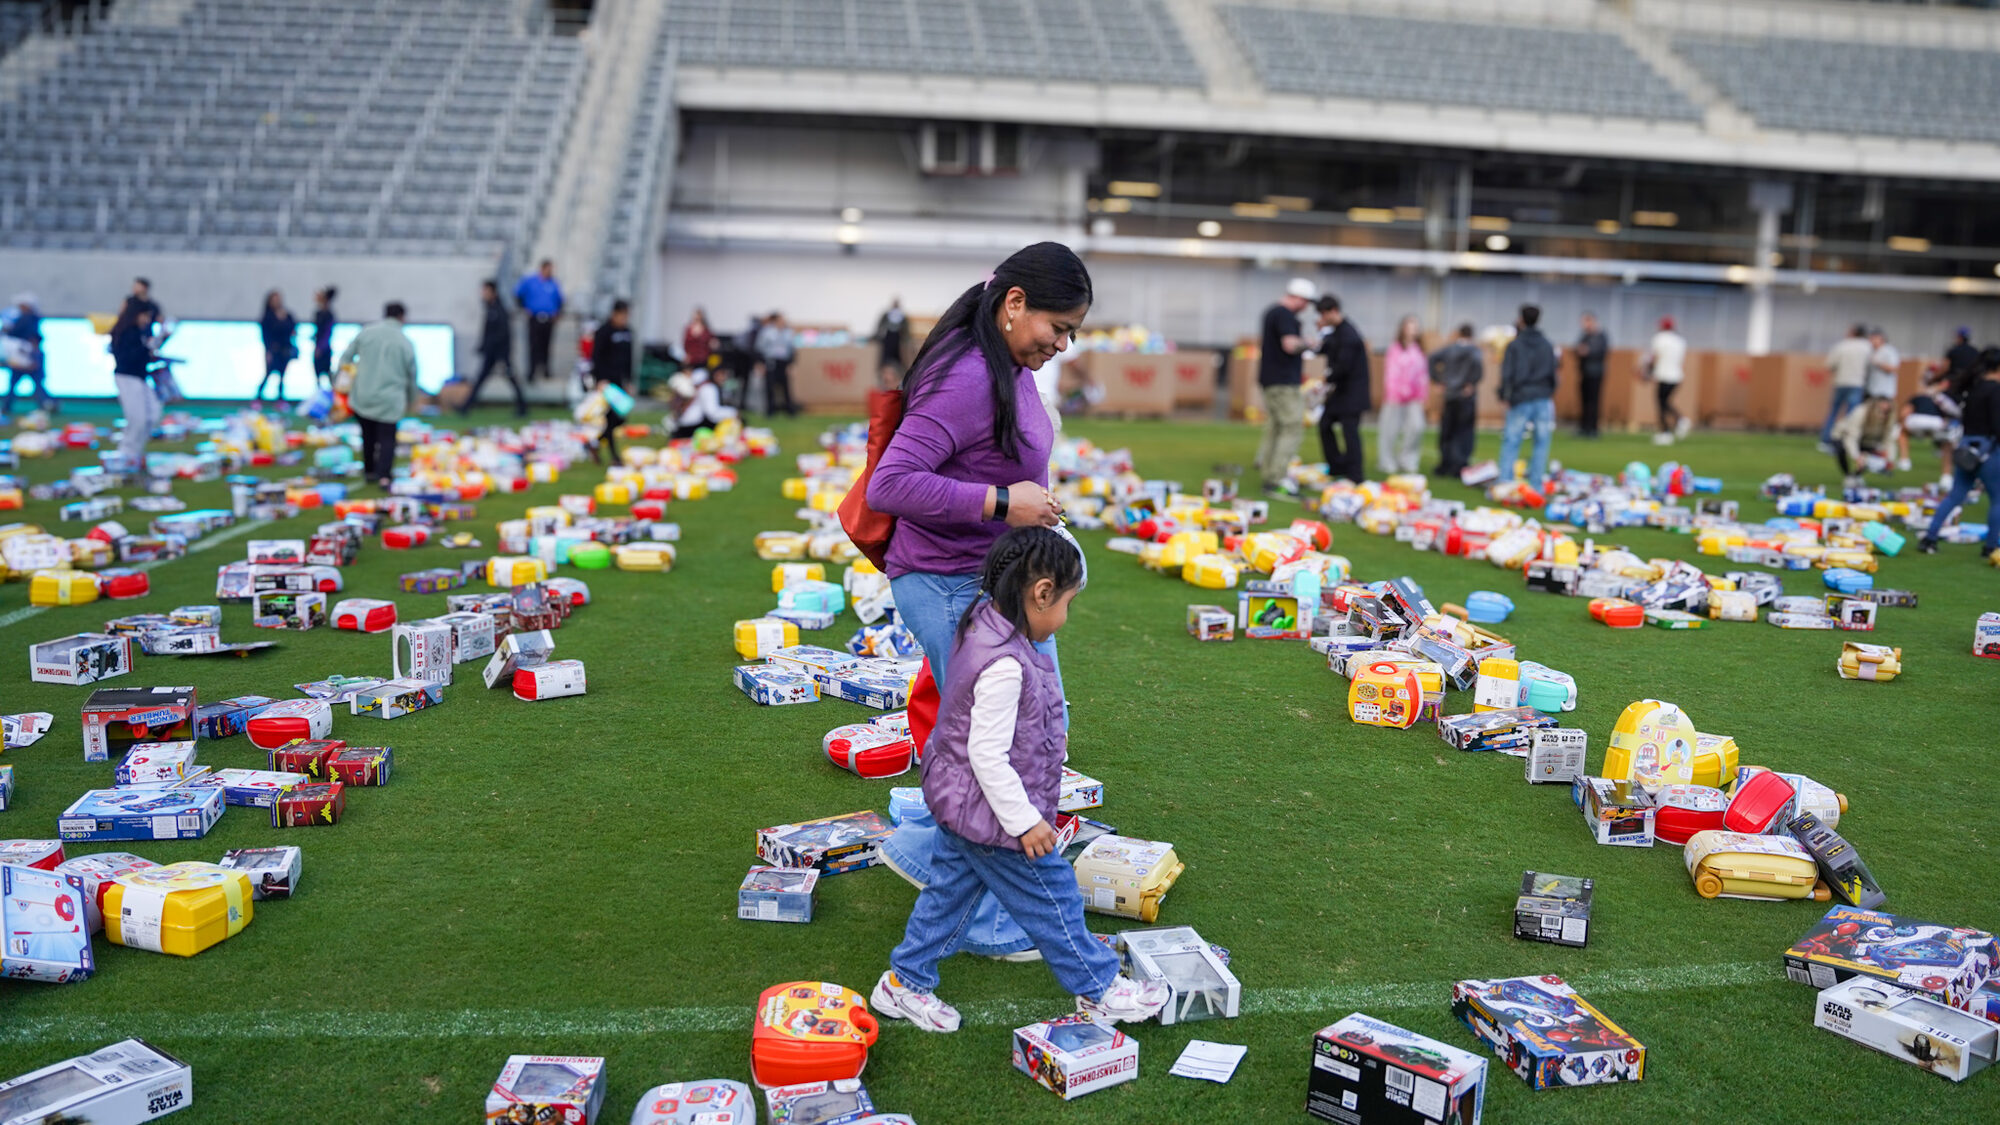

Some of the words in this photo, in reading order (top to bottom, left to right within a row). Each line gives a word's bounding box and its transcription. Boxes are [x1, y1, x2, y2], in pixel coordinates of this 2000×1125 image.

[37, 666, 72, 678] TRANSFORMERS
[129, 709, 171, 722] TUMBLER
[147, 713, 179, 725] VENOM
[1824, 1001, 1853, 1016] STAR
[1824, 1006, 1853, 1021] WARS
[529, 1056, 602, 1064] TRANSFORMERS
[1069, 1063, 1122, 1089] TRANSFORMERS
[148, 1090, 183, 1107] WARS
[1385, 1091, 1410, 1107] WORLD
[148, 1098, 183, 1115] STAR
